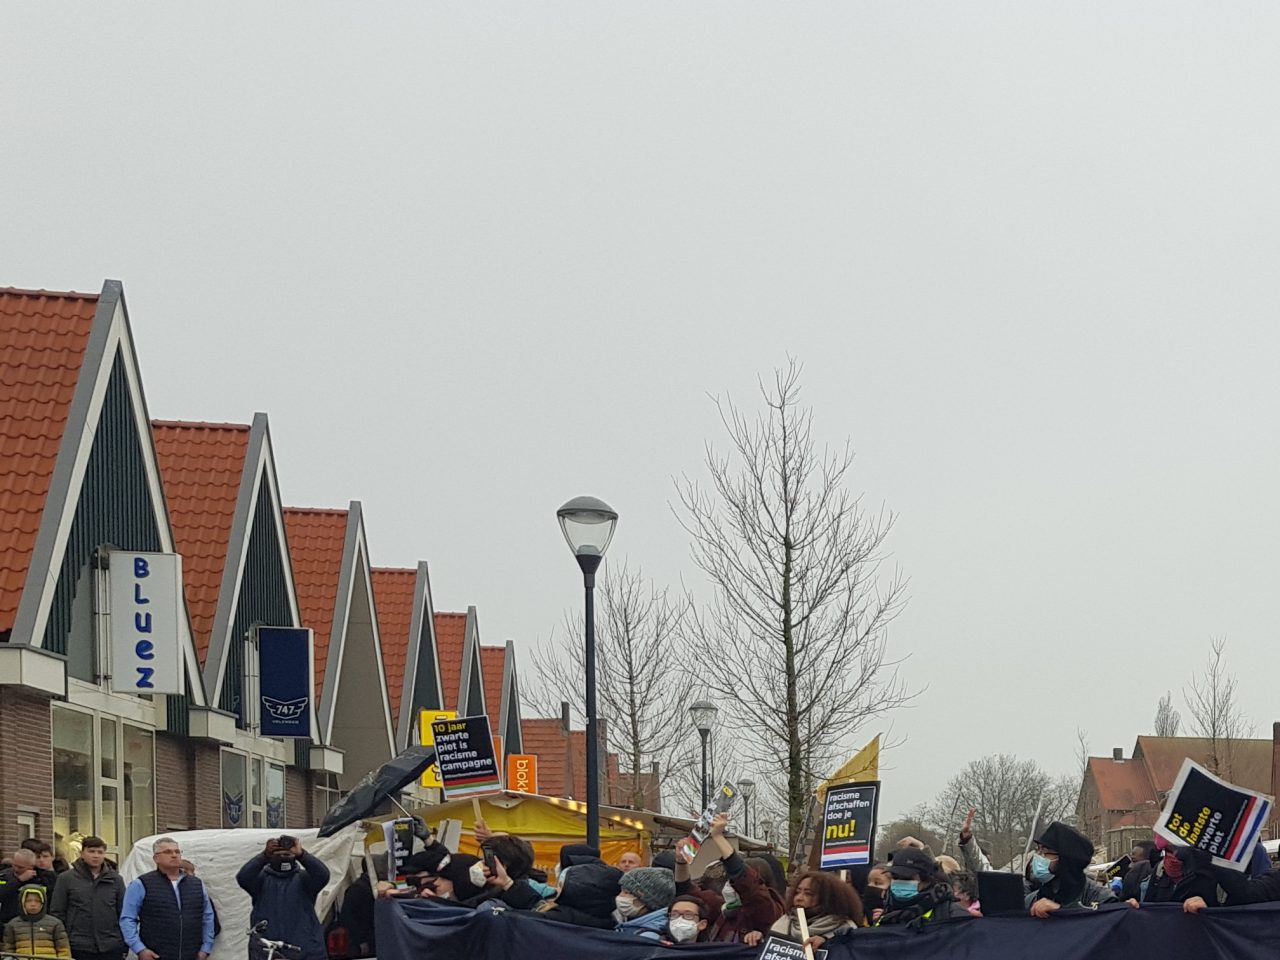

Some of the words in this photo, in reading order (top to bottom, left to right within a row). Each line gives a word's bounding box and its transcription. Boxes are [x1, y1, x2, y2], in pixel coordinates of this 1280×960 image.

[433, 724, 446, 733] 10
[447, 722, 467, 732] jaar
[436, 731, 469, 743] zwarte
[438, 742, 457, 753] piet
[459, 741, 468, 750] is
[439, 751, 478, 762] racisme
[441, 758, 493, 771] campagne
[829, 792, 860, 802] racisme
[828, 800, 870, 811] afschaffen
[827, 811, 842, 820] doe
[843, 810, 852, 819] je
[1168, 813, 1183, 831] tot
[826, 819, 856, 839] nu!
[1179, 822, 1191, 838] de
[1198, 811, 1222, 850] zwarte
[1208, 832, 1225, 854] piet
